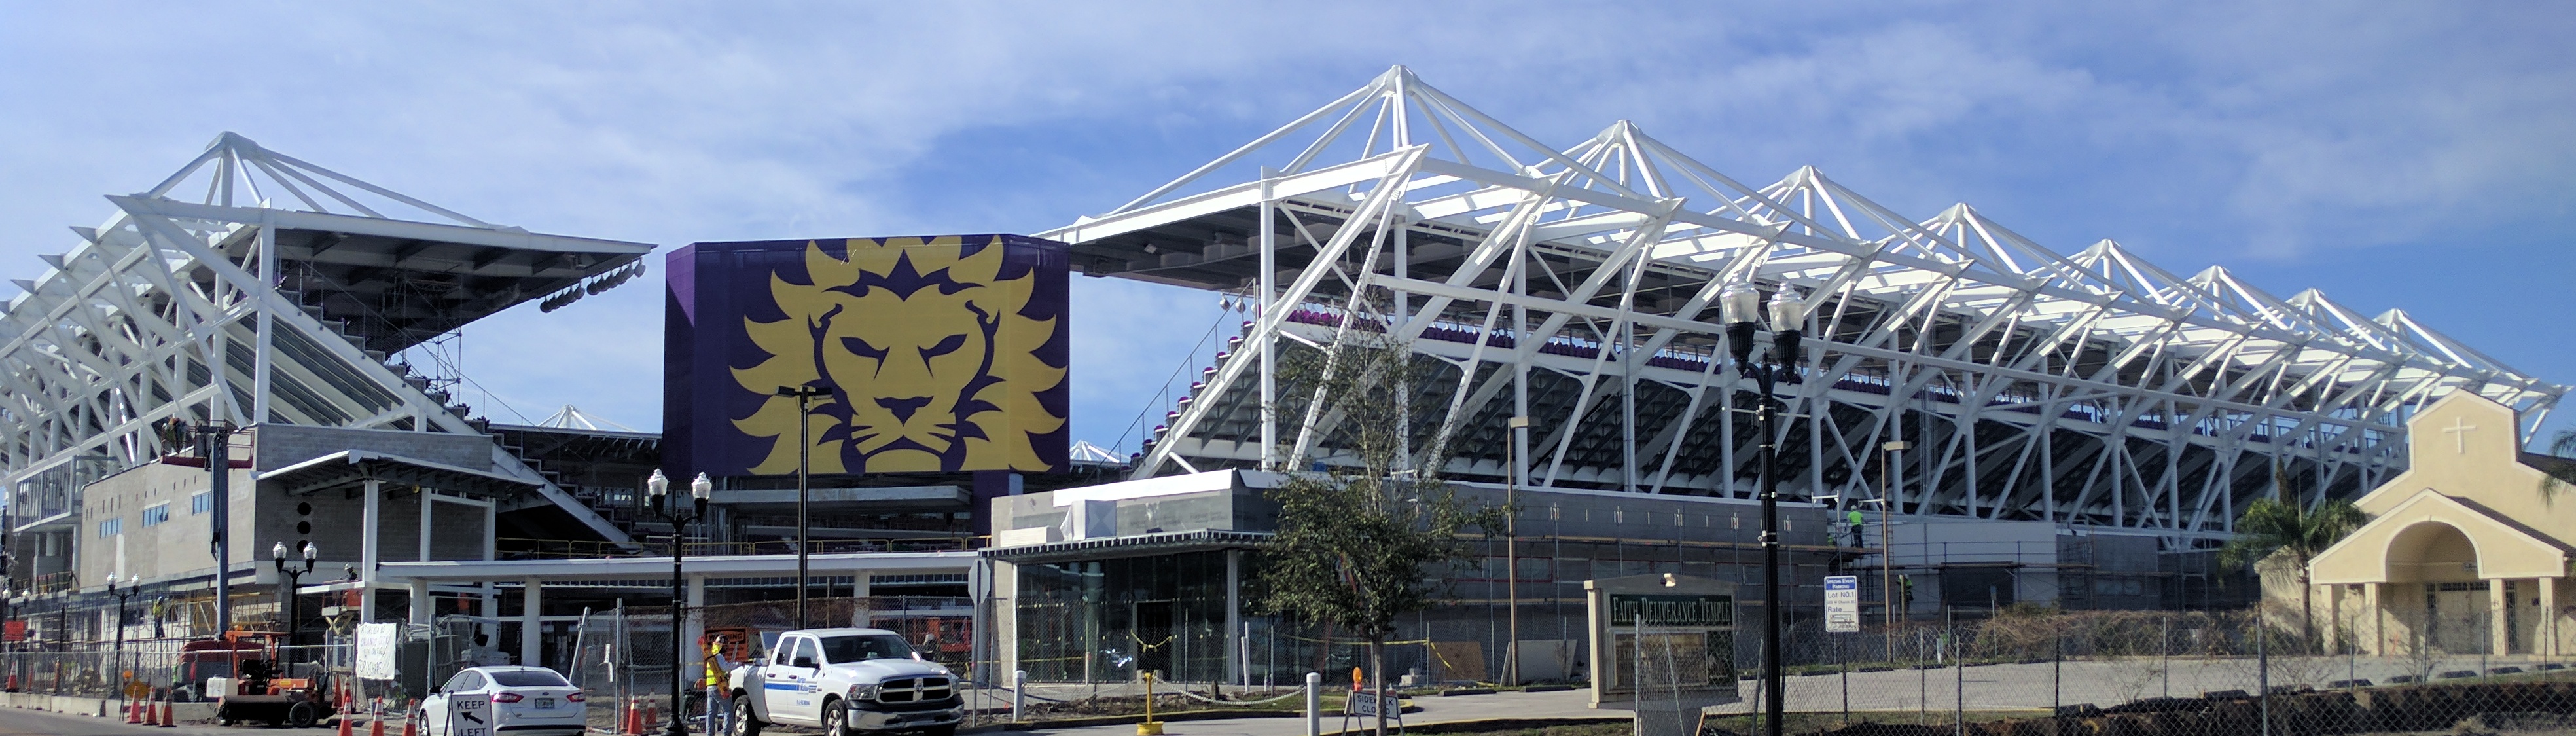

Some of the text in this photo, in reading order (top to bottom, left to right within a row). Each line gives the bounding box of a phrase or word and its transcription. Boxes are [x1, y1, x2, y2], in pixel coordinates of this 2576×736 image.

[709, 633, 743, 641] WANING
[457, 700, 486, 710] KEEP
[1357, 695, 1393, 706] SIDEK
[1362, 705, 1391, 715] CLOD
[460, 727, 487, 736] LEFT
